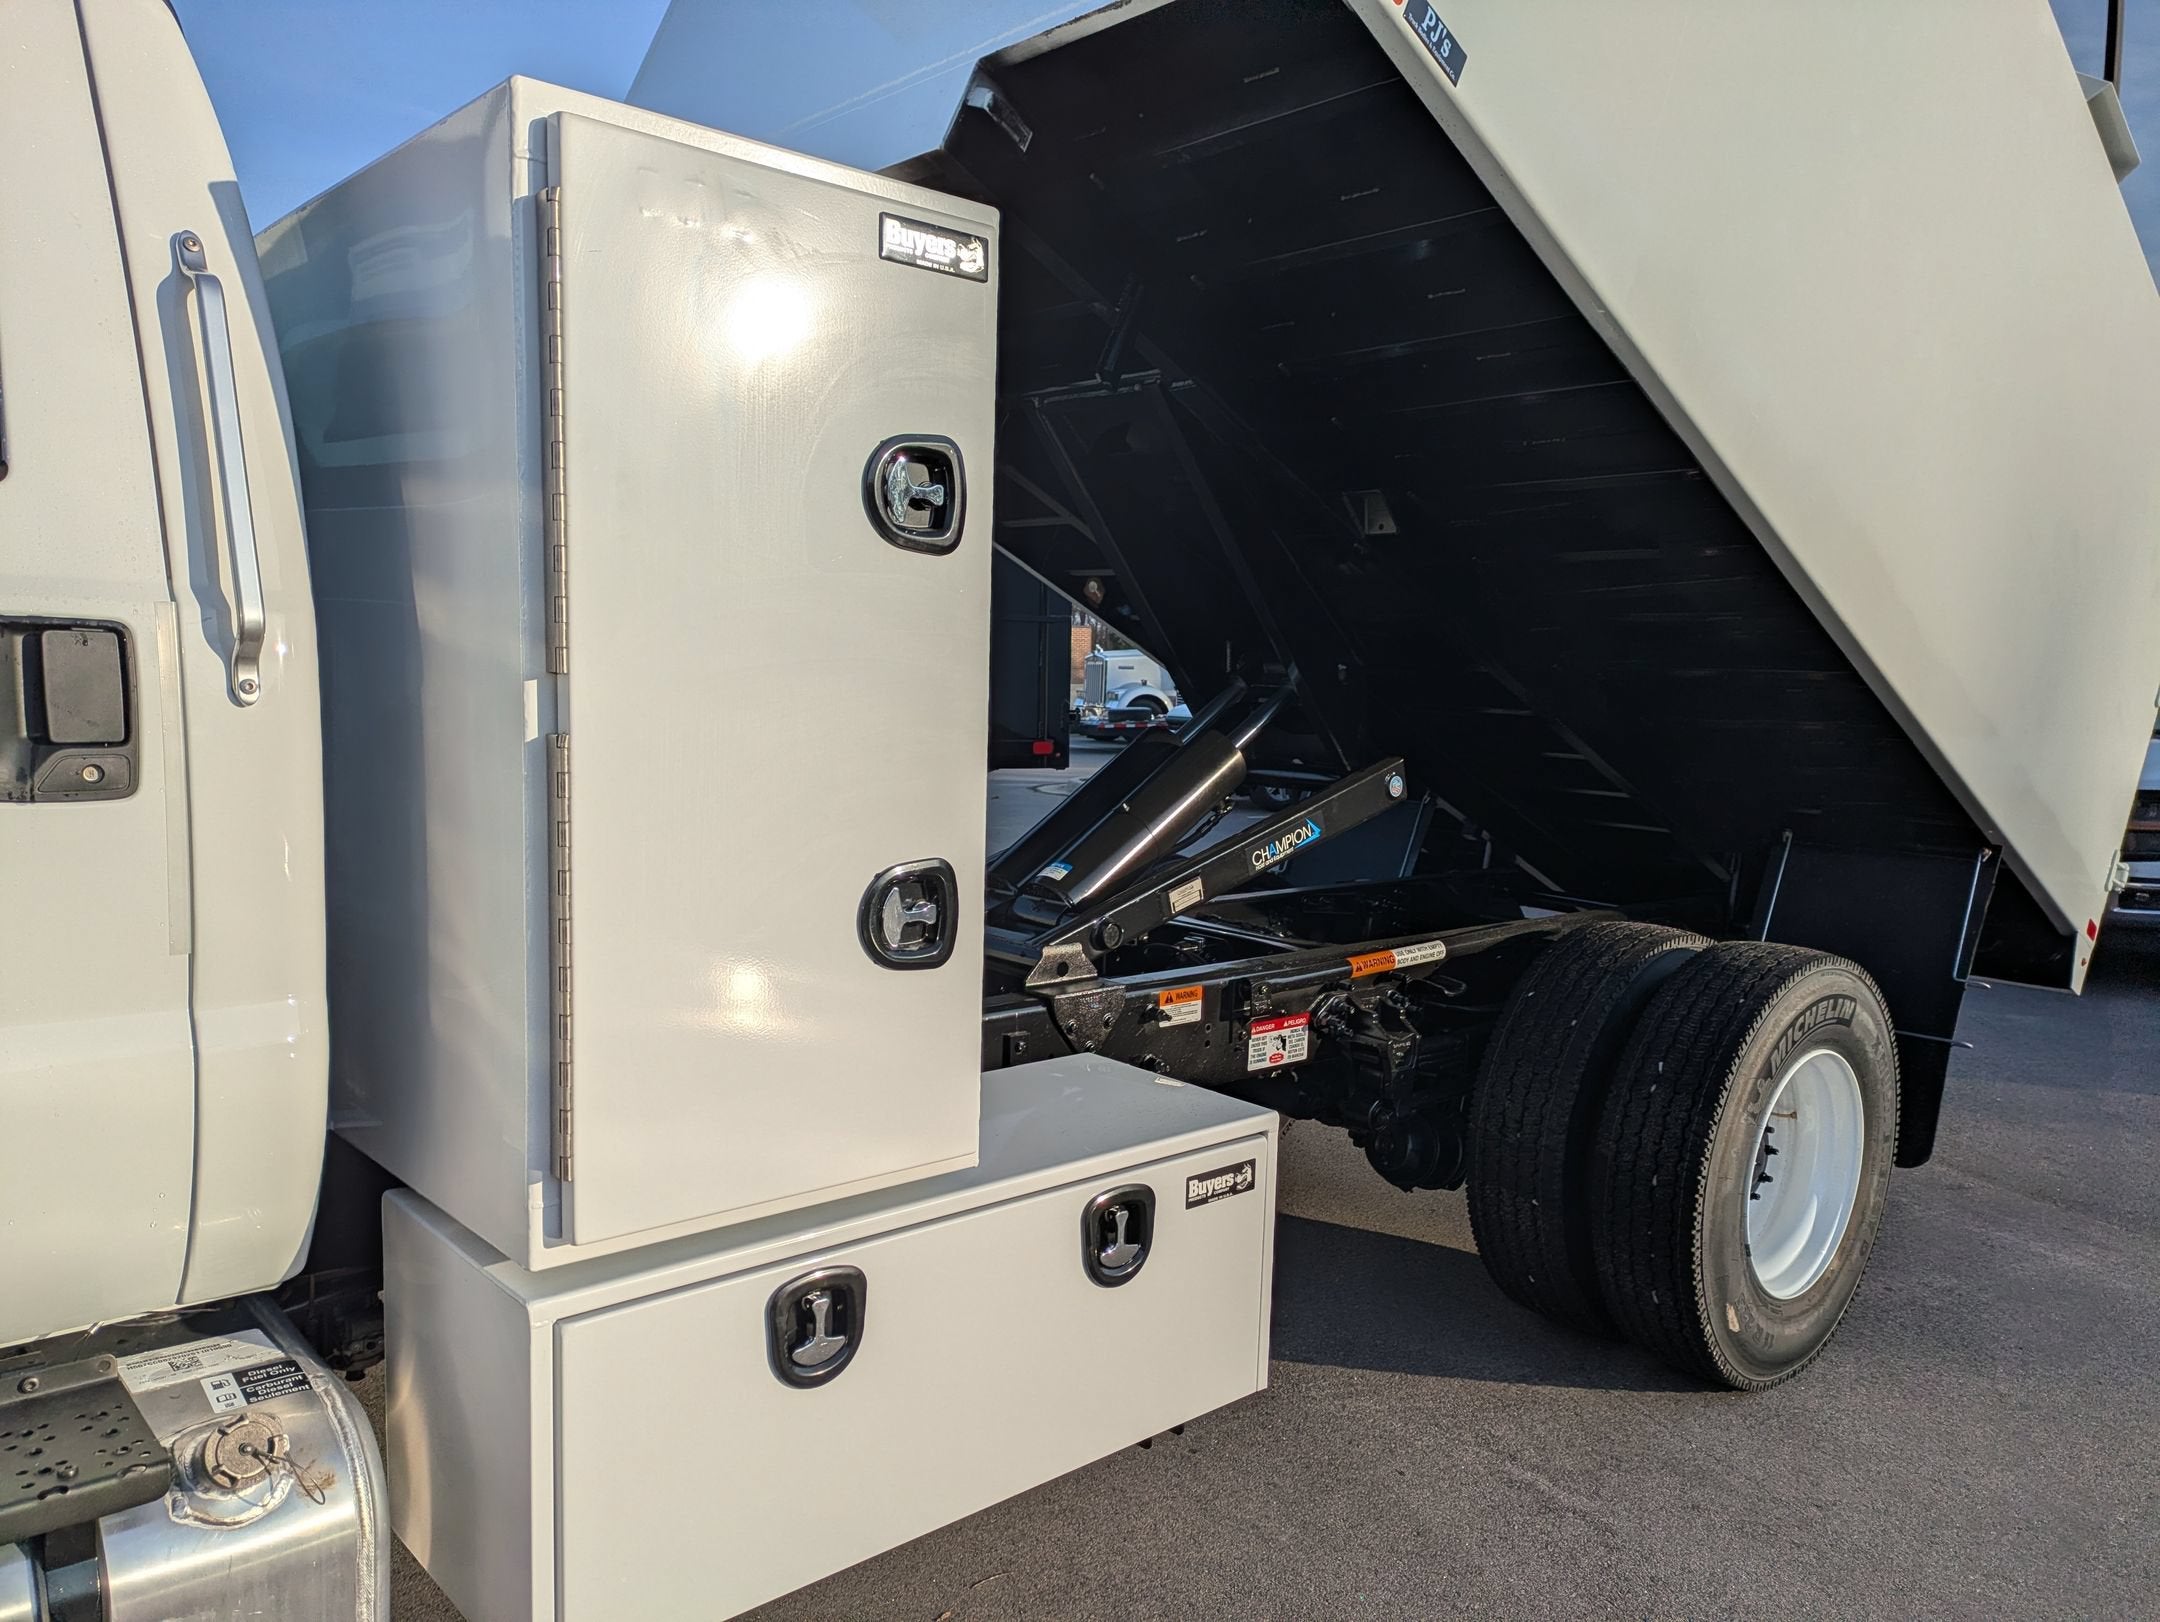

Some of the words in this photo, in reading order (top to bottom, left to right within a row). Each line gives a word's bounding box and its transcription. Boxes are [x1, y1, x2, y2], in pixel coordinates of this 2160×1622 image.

[1422, 6, 1451, 57] PJ's
[884, 218, 956, 258] Buyers
[1252, 824, 1311, 865] CHAMPION
[1405, 947, 1417, 955] ONLY
[1417, 945, 1428, 953] WITH
[1362, 955, 1395, 969] WARNING
[1397, 957, 1408, 965] BODY
[1420, 952, 1435, 960] ENGINE
[1176, 990, 1197, 1000] WARNING
[1771, 997, 1856, 1075] MICHELIN
[1189, 1173, 1234, 1198] Buyers
[242, 1373, 267, 1383] Fuel
[270, 1367, 295, 1376] Only
[248, 1365, 282, 1376] Diesel
[246, 1375, 303, 1392] Carburant
[258, 1383, 293, 1395] Diesel
[249, 1384, 310, 1403] Seulement
